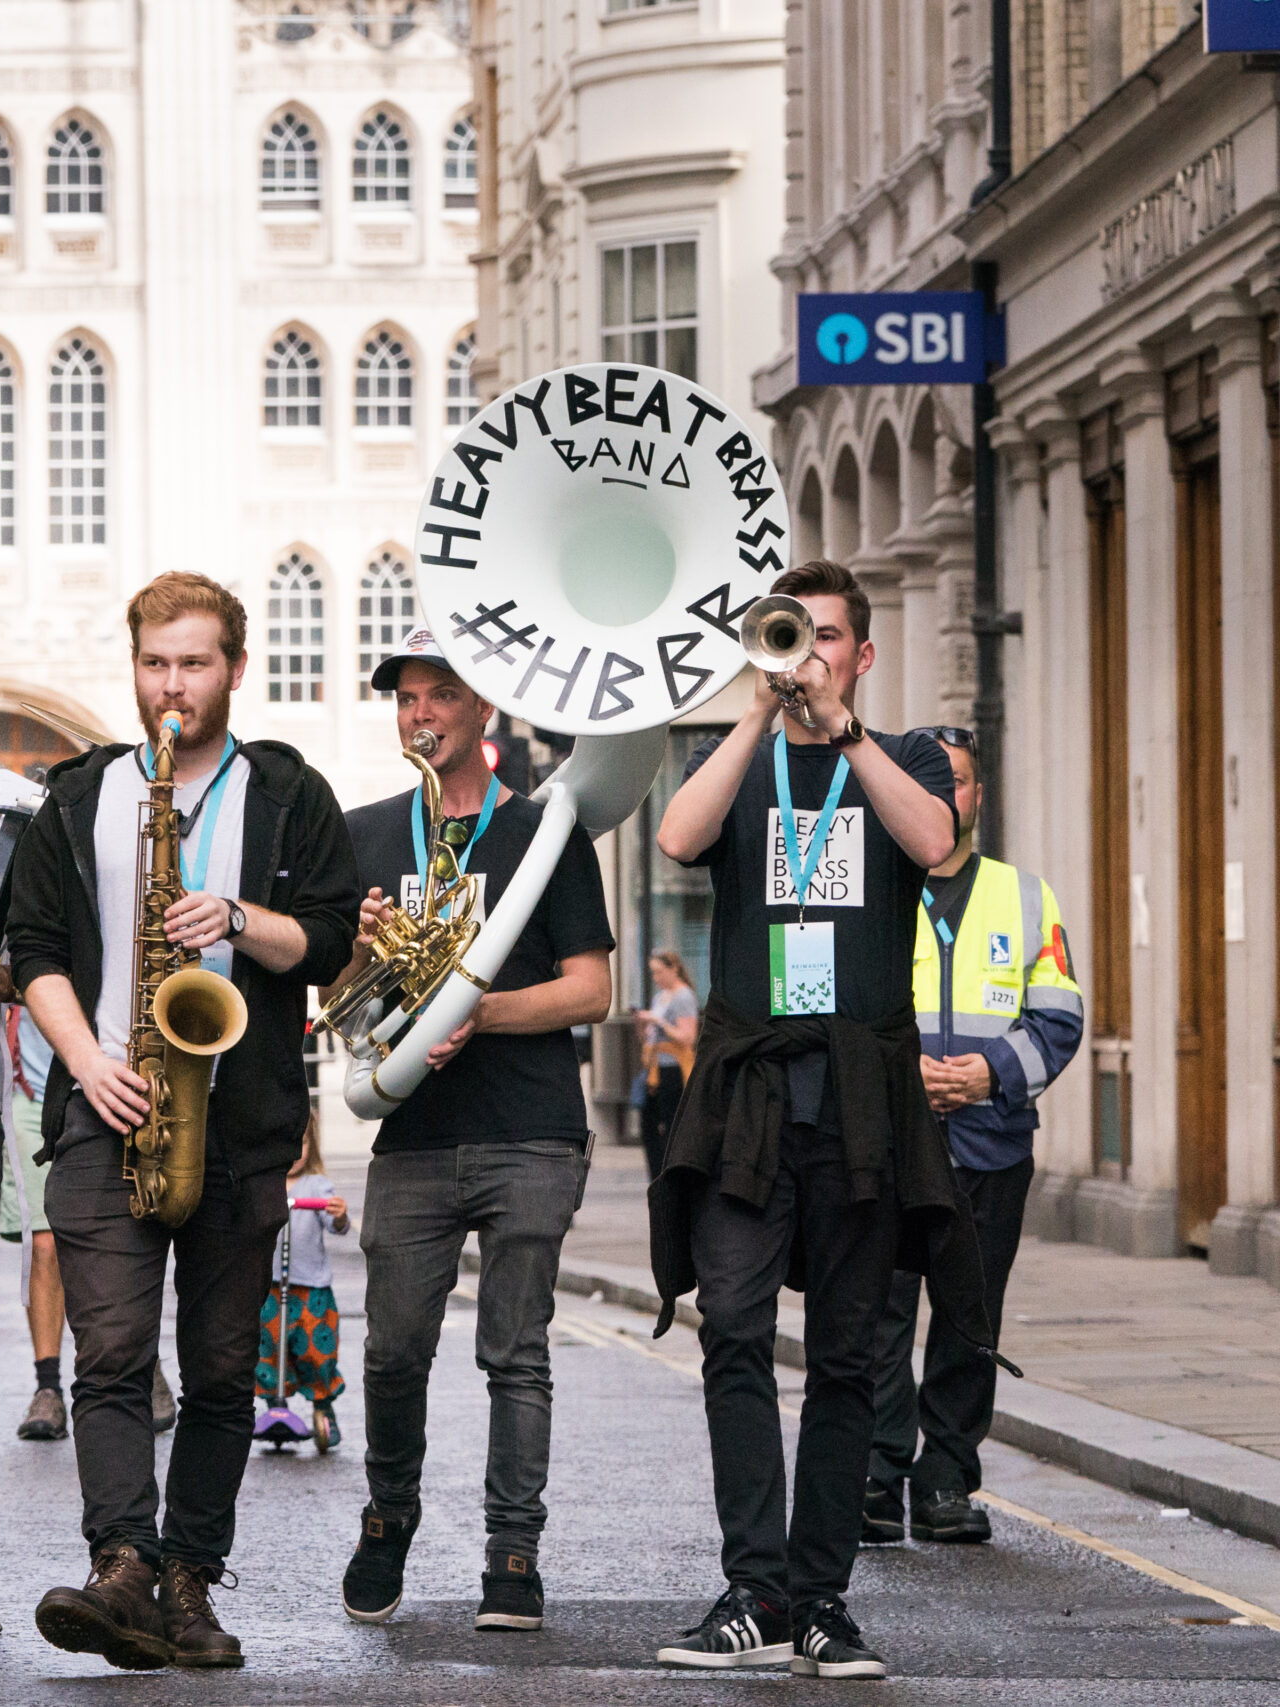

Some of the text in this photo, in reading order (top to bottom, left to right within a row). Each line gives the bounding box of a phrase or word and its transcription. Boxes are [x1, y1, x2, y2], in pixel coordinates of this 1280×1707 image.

[875, 312, 965, 364] SBI
[421, 369, 785, 574] HEAVY BEAT BRASS
[551, 437, 690, 489] BAND
[773, 976, 784, 1010] ARTIST
[992, 991, 1015, 1006] 1271
